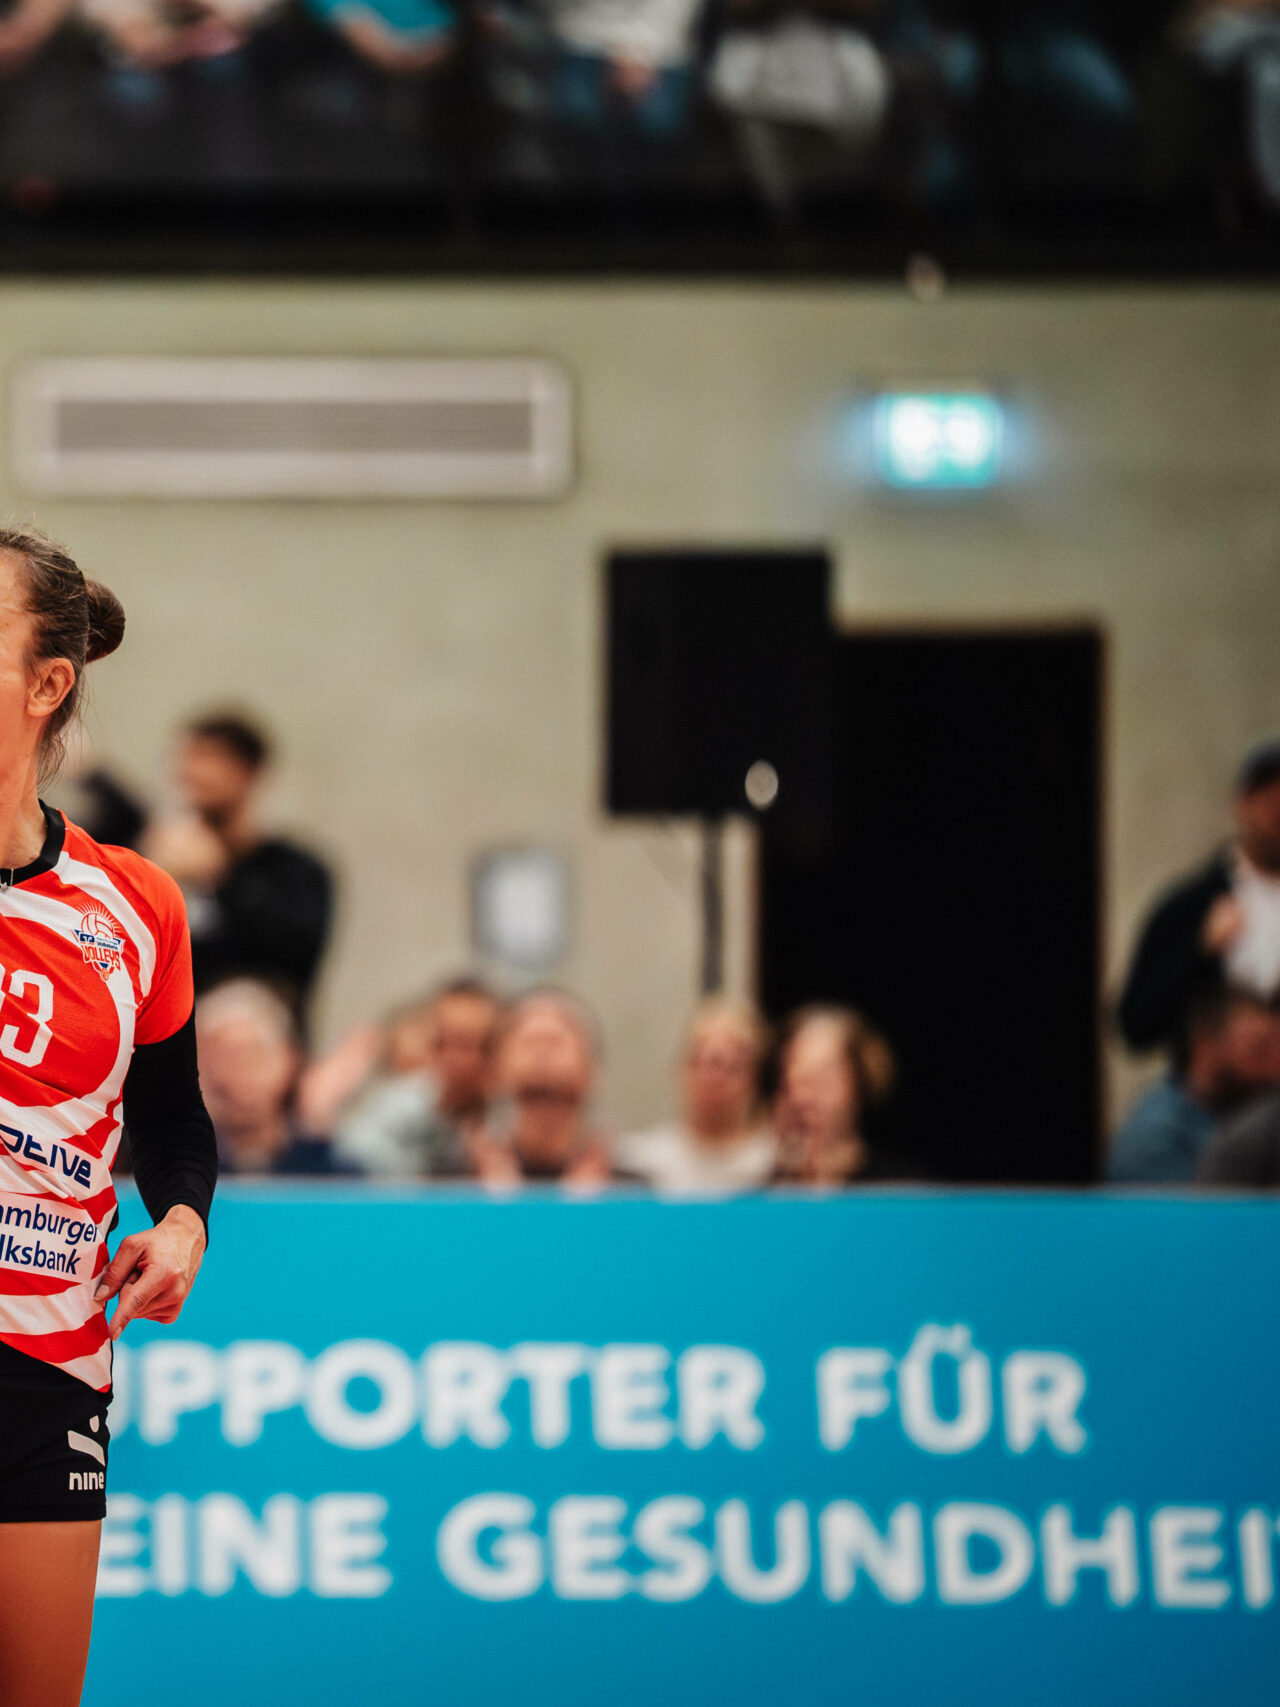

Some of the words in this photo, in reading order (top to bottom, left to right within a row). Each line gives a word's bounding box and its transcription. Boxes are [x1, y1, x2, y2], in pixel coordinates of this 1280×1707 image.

[81, 945, 121, 971] VOLLEYS
[110, 1338, 766, 1451] PPORTER
[817, 1322, 1088, 1456] FÜR
[69, 1471, 105, 1491] nine
[436, 1492, 1280, 1612] GESUNDHEI
